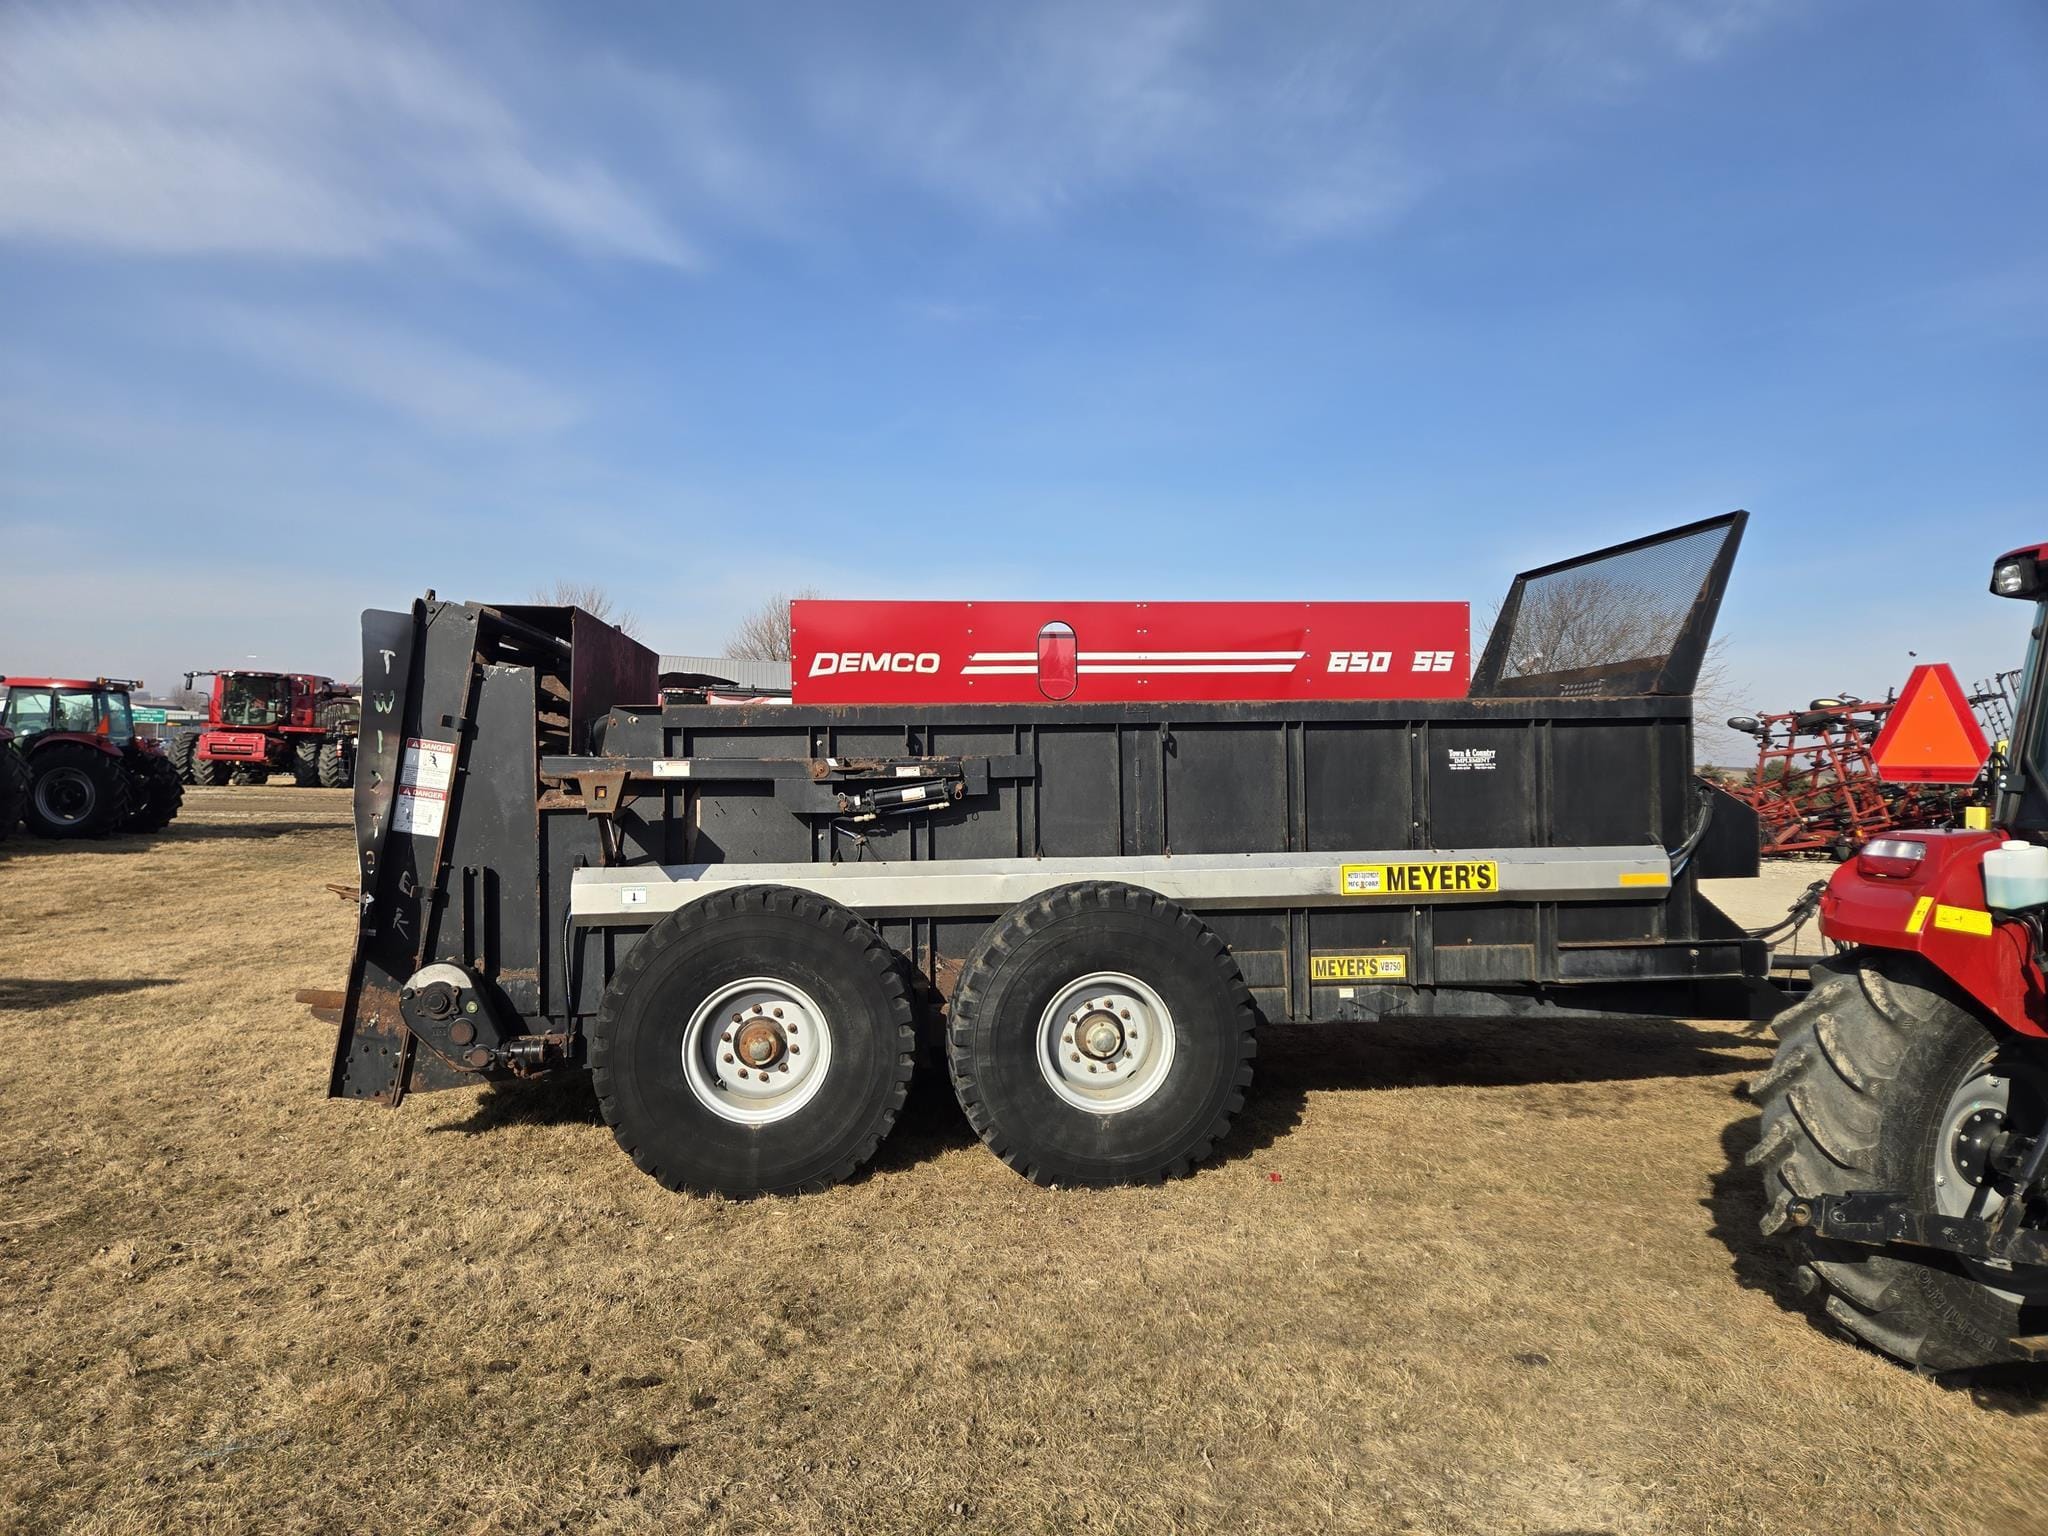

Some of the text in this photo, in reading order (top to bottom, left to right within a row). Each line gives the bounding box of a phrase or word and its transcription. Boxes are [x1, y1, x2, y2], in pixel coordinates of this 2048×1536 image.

[808, 652, 940, 678] DEMCO
[1327, 651, 1393, 673] 650
[421, 743, 452, 752] DANGER
[1448, 749, 1465, 757] Town
[1472, 749, 1496, 759] Country
[412, 789, 443, 799] DANGER
[1387, 865, 1491, 891] MEYER'S
[1315, 958, 1378, 977] MEYER'S
